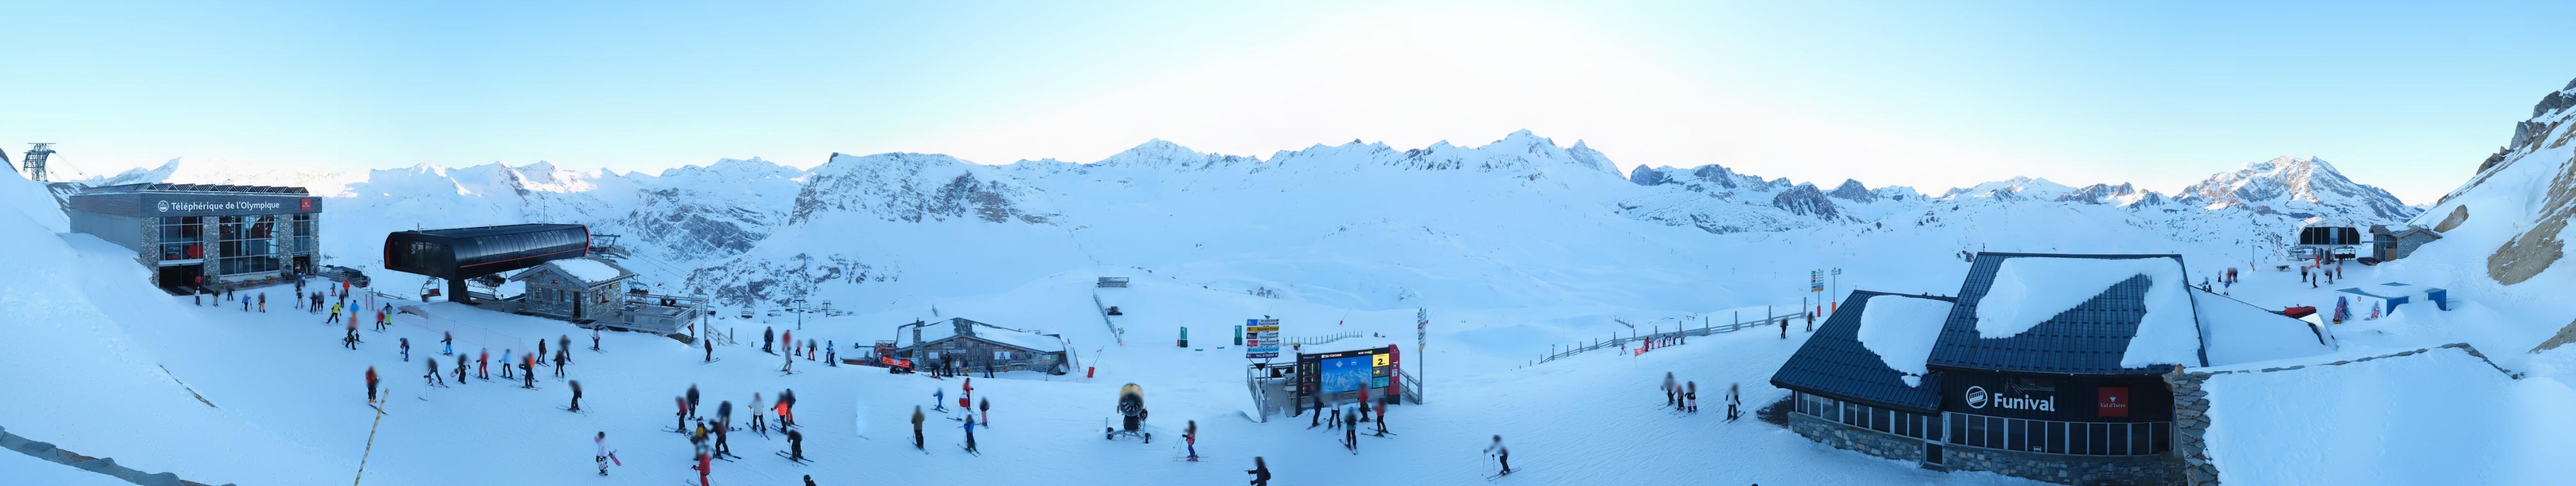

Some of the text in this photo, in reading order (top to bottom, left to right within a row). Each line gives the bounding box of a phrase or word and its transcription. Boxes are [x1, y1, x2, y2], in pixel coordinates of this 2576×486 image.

[171, 202, 223, 212] Téléphérique
[226, 201, 234, 210] de
[1994, 393, 2055, 411] Funival
